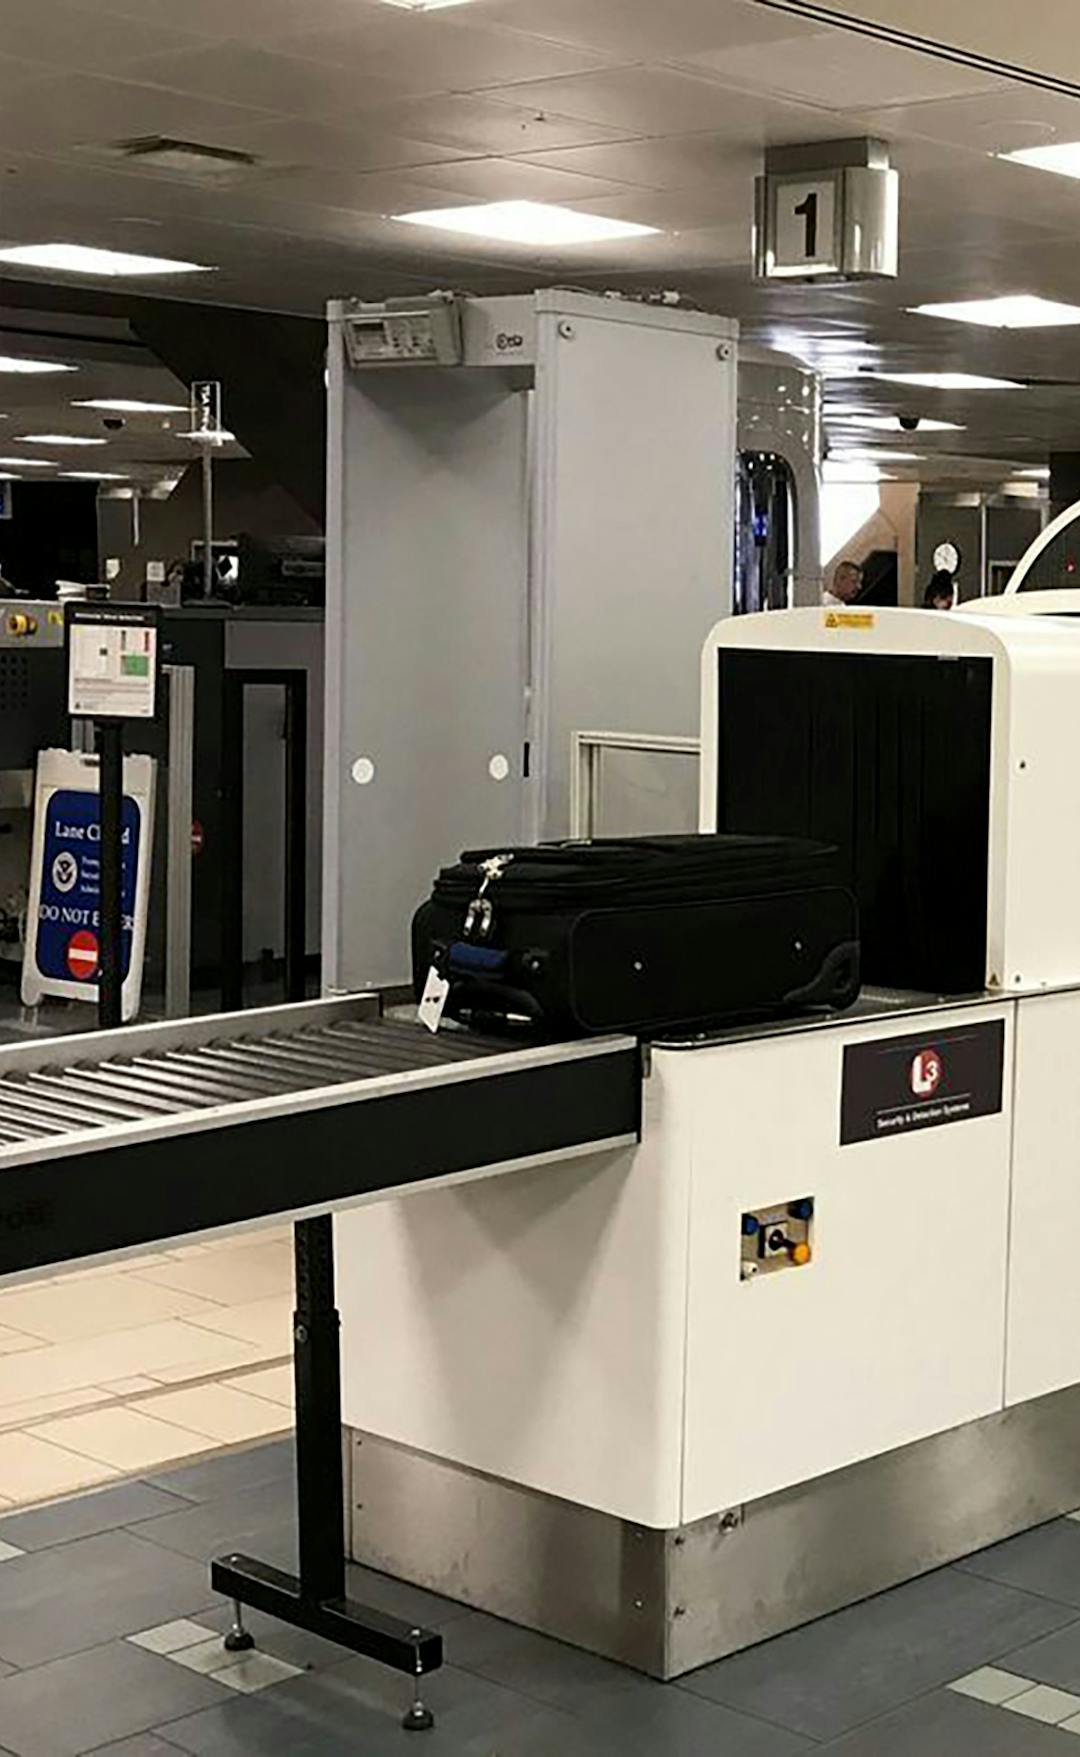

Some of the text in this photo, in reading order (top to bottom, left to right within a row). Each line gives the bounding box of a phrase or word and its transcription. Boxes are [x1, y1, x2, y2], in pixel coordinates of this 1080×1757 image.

[794, 192, 817, 257] 1
[55, 821, 85, 840] Lane
[39, 904, 60, 921] DO
[61, 907, 90, 925] NOT
